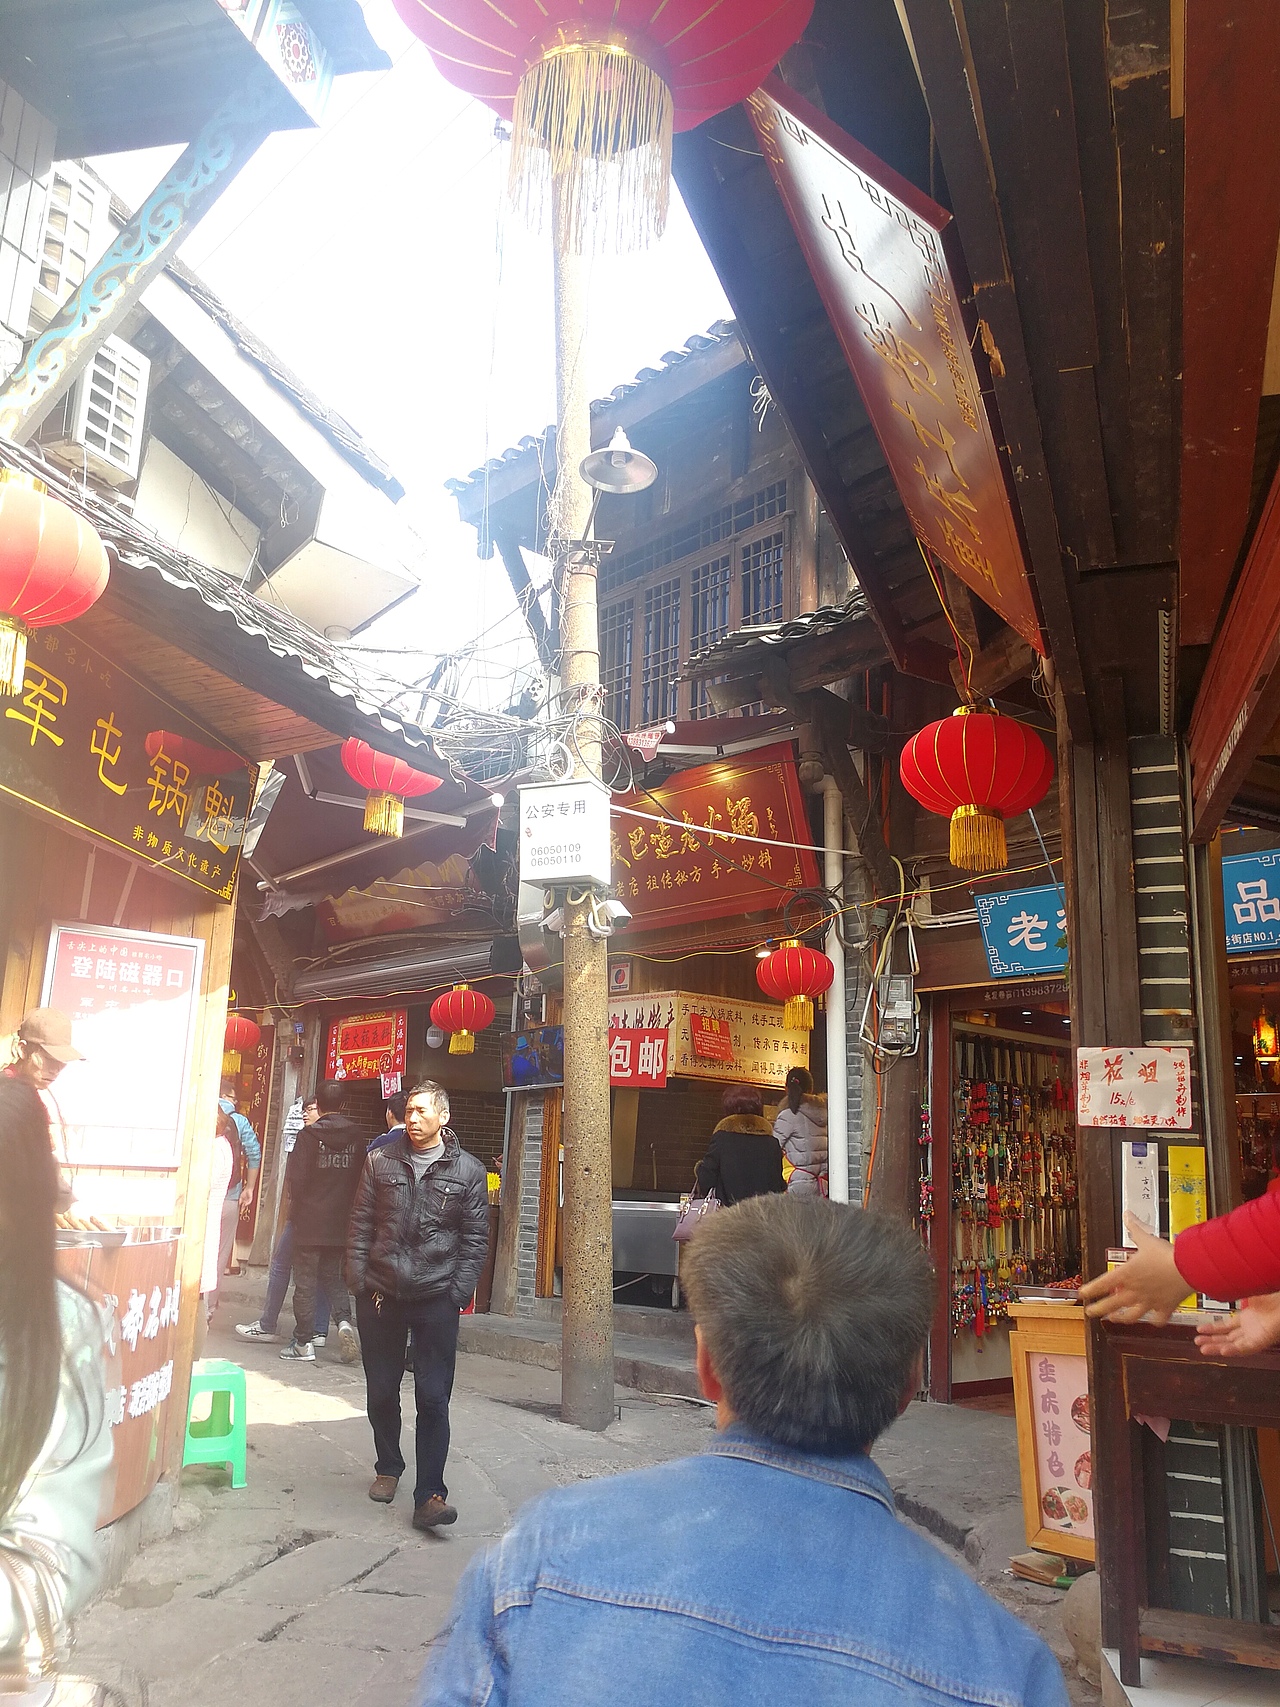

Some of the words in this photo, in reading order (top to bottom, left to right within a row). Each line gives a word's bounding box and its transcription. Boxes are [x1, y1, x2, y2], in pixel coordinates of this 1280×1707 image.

[526, 800, 586, 819] 公安专用
[133, 825, 222, 878] 非物质文化遗产
[531, 843, 581, 856] 06050109
[531, 854, 582, 867] 06050110
[646, 866, 703, 892] 祖传秘方
[711, 848, 773, 879] 手工炒料
[66, 941, 128, 957] 舌尖上的中国
[71, 956, 184, 988] 登陆磁器口
[609, 1035, 665, 1080] 包邮
[1039, 1357, 1065, 1478] 重庆特色
